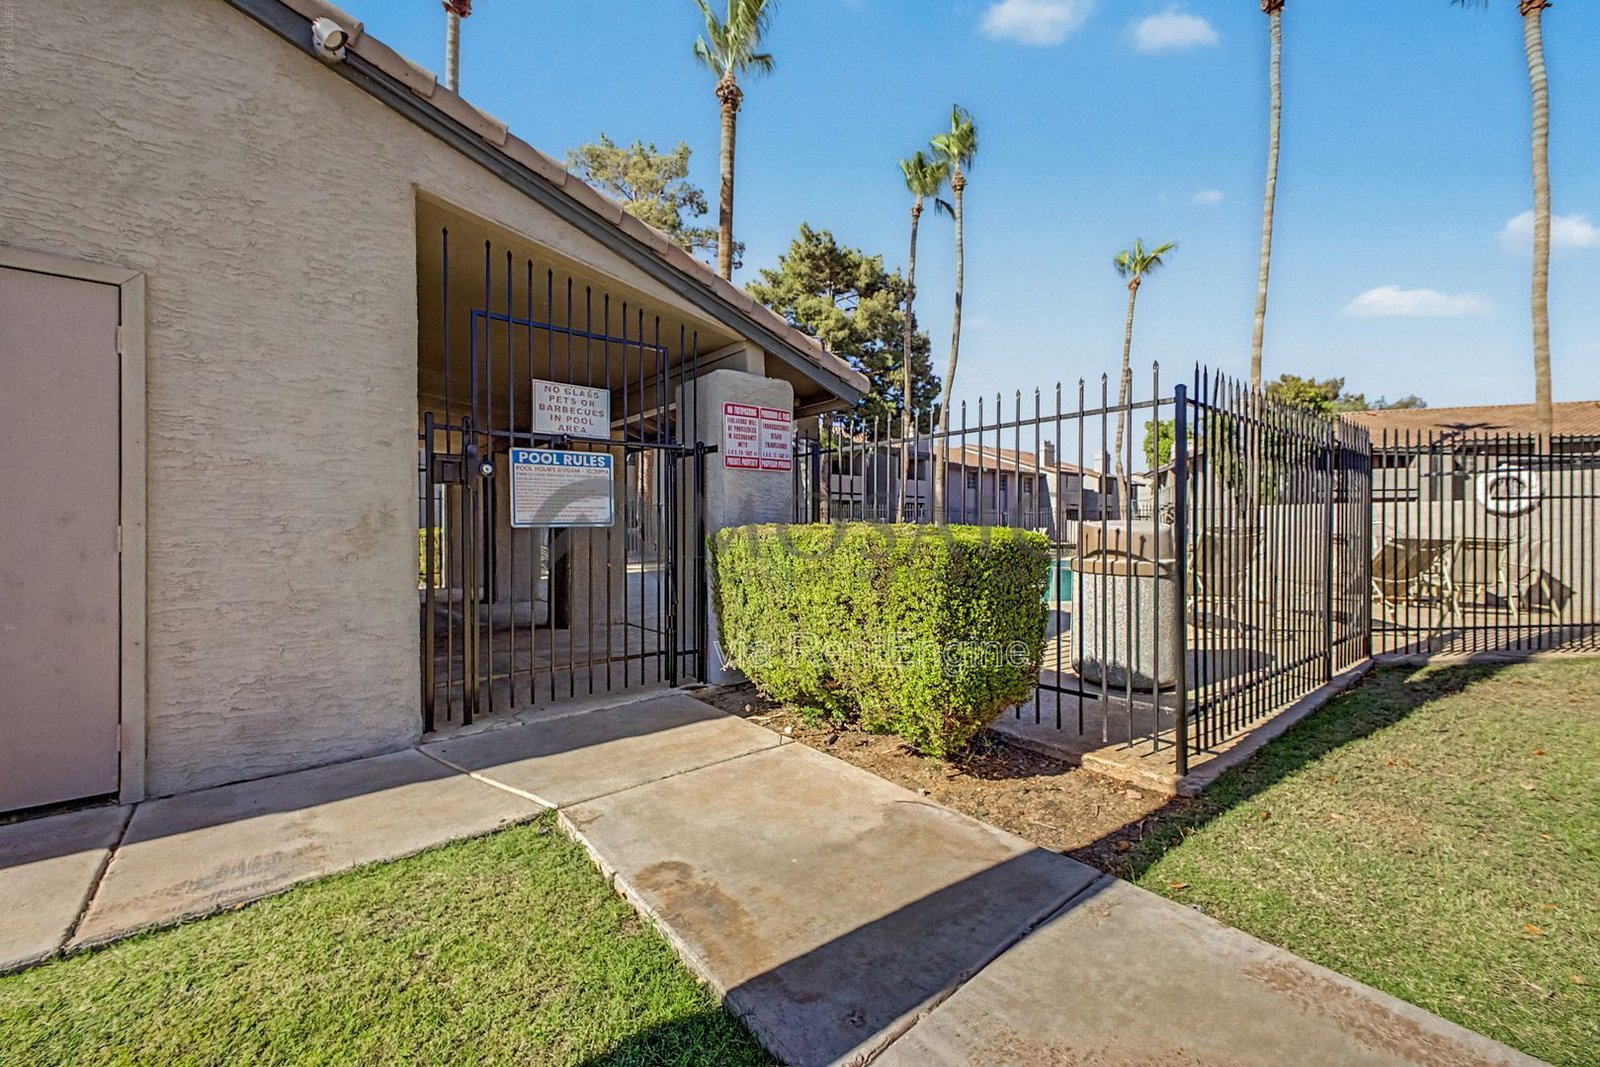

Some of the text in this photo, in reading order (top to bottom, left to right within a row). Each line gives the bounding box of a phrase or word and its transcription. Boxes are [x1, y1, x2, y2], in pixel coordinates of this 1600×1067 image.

[544, 385, 600, 399] NO GLASS
[549, 395, 595, 407] PETS OR
[538, 403, 605, 418] BARBECUES
[549, 414, 594, 426] IN POOL
[557, 424, 587, 434] AREA
[518, 451, 605, 467] POOL RULES
